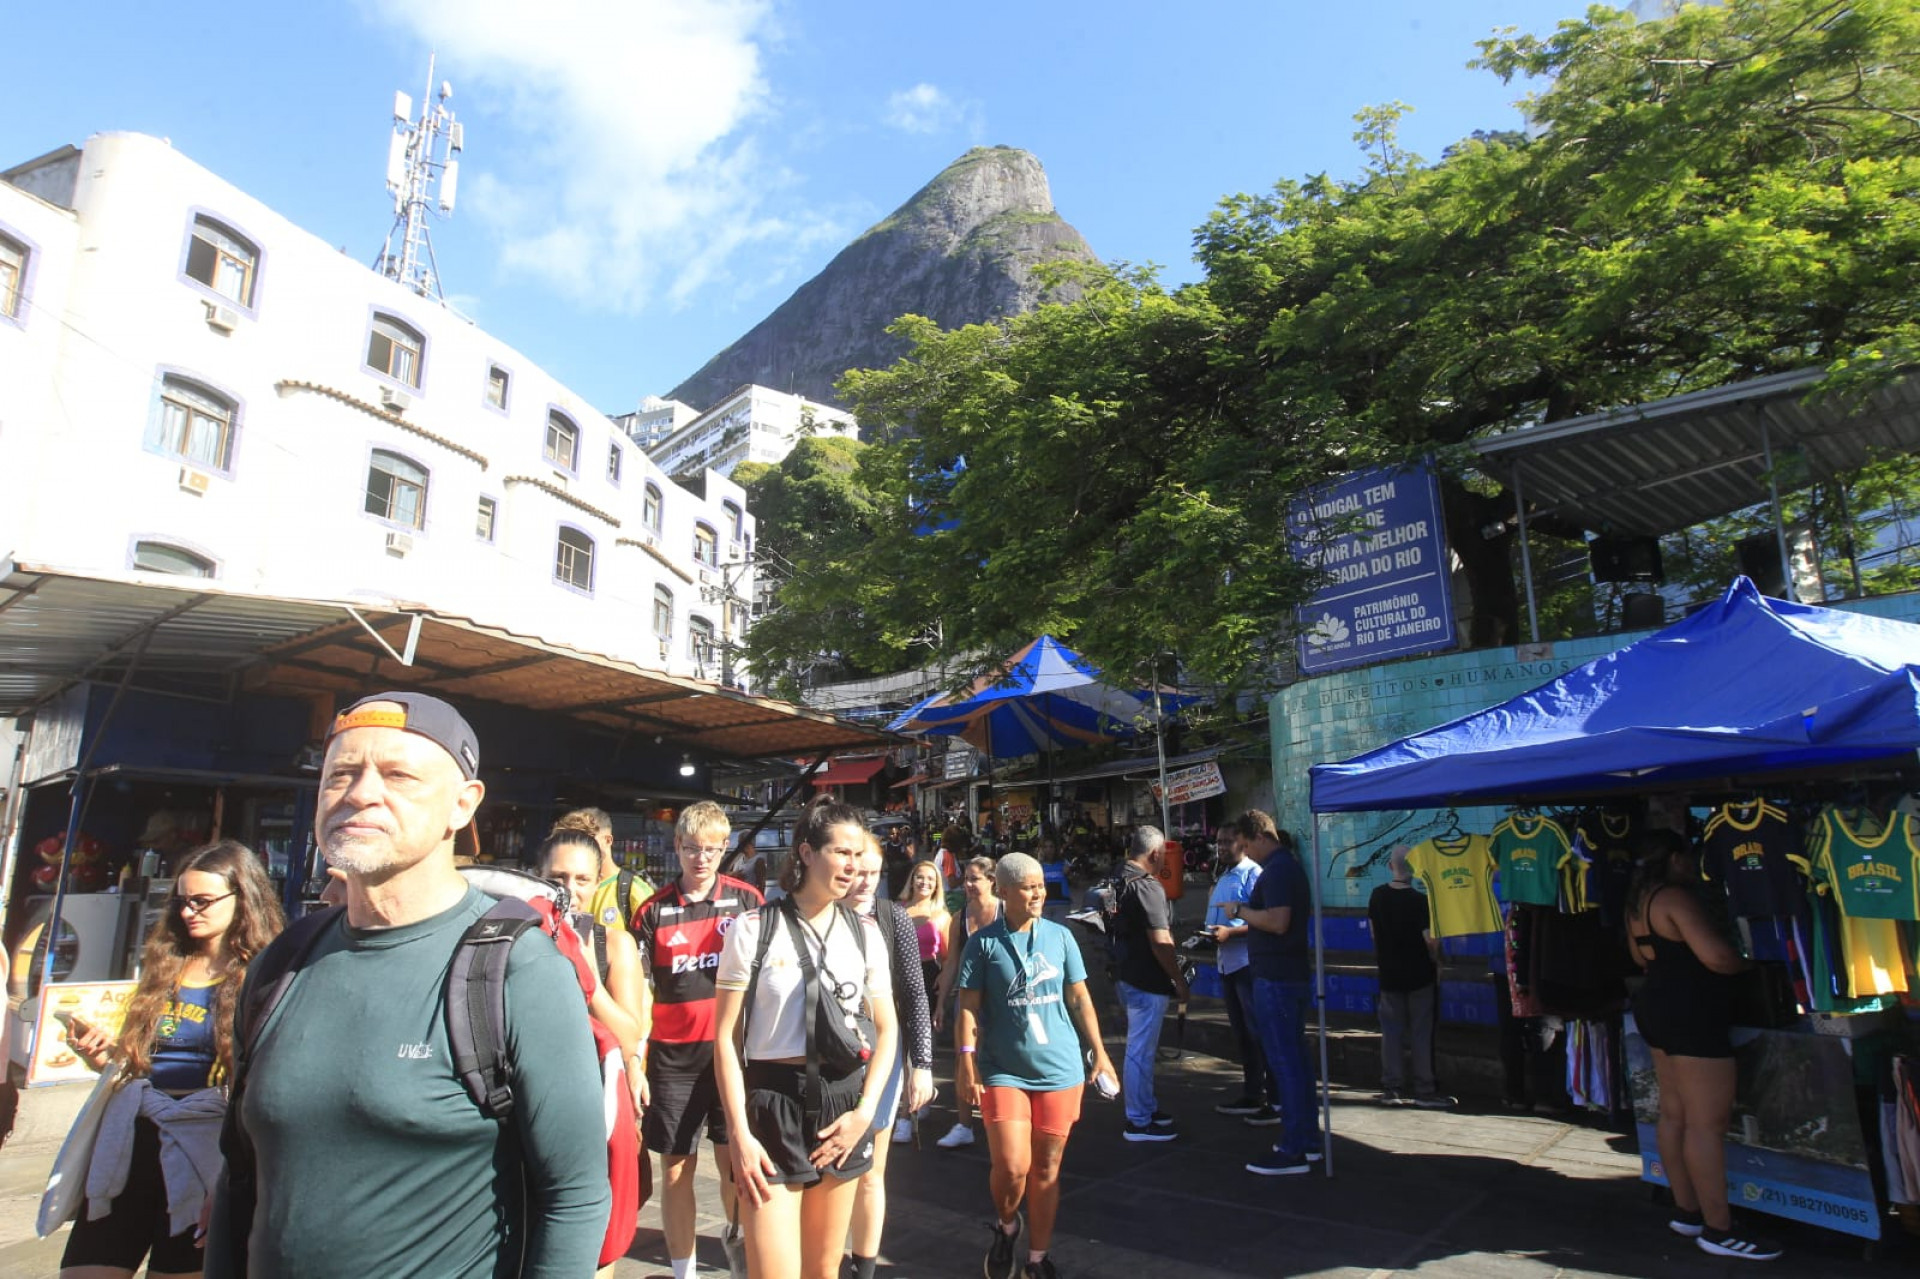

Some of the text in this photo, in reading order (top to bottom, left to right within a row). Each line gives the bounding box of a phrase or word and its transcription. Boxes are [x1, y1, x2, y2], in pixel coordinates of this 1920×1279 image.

[1310, 493, 1362, 521] VIDIGAL
[1363, 481, 1396, 505] TEM
[1365, 509, 1386, 527] DE
[1353, 540, 1362, 557] A
[1366, 521, 1428, 553] MELHOR
[1371, 555, 1392, 575] DO
[1395, 547, 1421, 569] RIO
[1354, 593, 1419, 618] PATRIMÔNIO
[1355, 606, 1426, 632] CULTURAL DO
[1356, 617, 1441, 645] RIO DE JANEIRO
[1321, 677, 1428, 705] DIREITOS
[1450, 660, 1570, 685] HUMANOS
[1847, 862, 1902, 882] BRASIL
[1761, 1187, 1869, 1223] (21) 982700095
